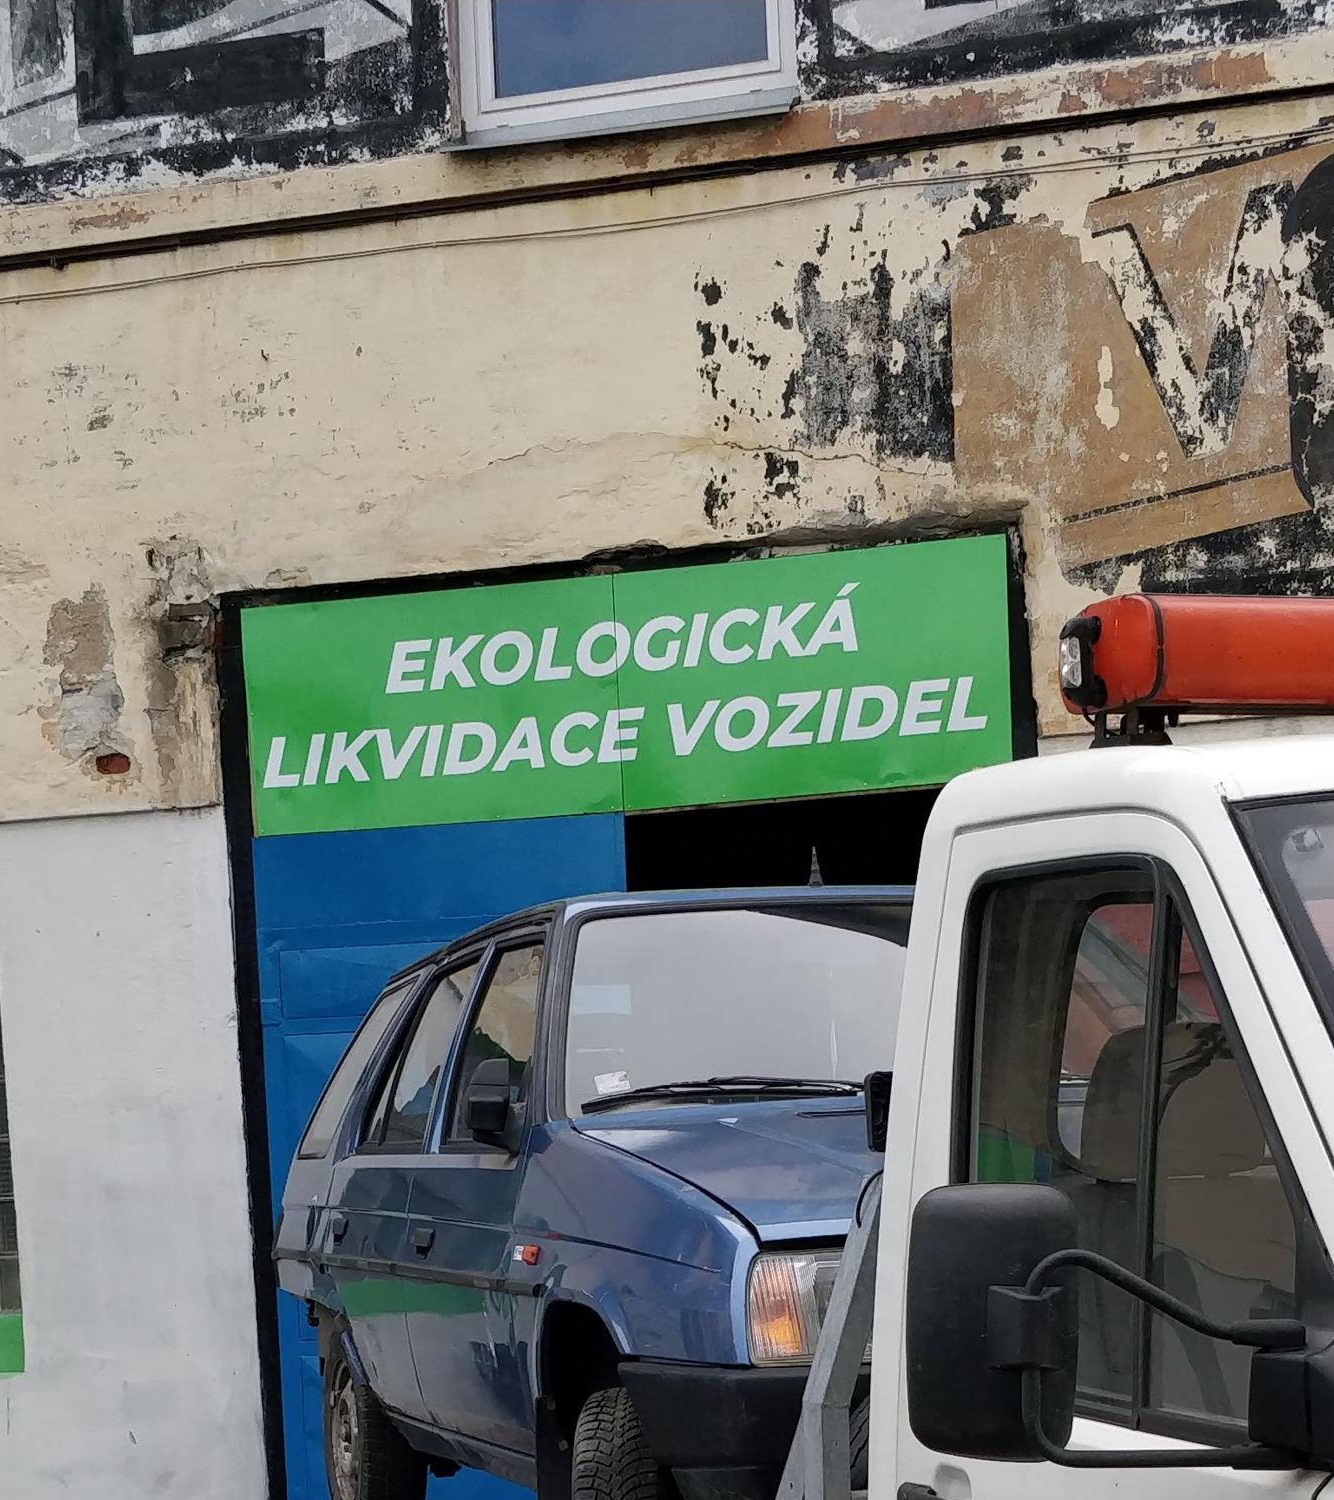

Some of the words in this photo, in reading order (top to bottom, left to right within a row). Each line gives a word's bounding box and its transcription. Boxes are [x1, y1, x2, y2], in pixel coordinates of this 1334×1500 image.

[386, 583, 860, 694] EKOLOGICKÁ
[263, 706, 645, 789] LIKVIDACE
[667, 676, 988, 756] VOZIDEL
